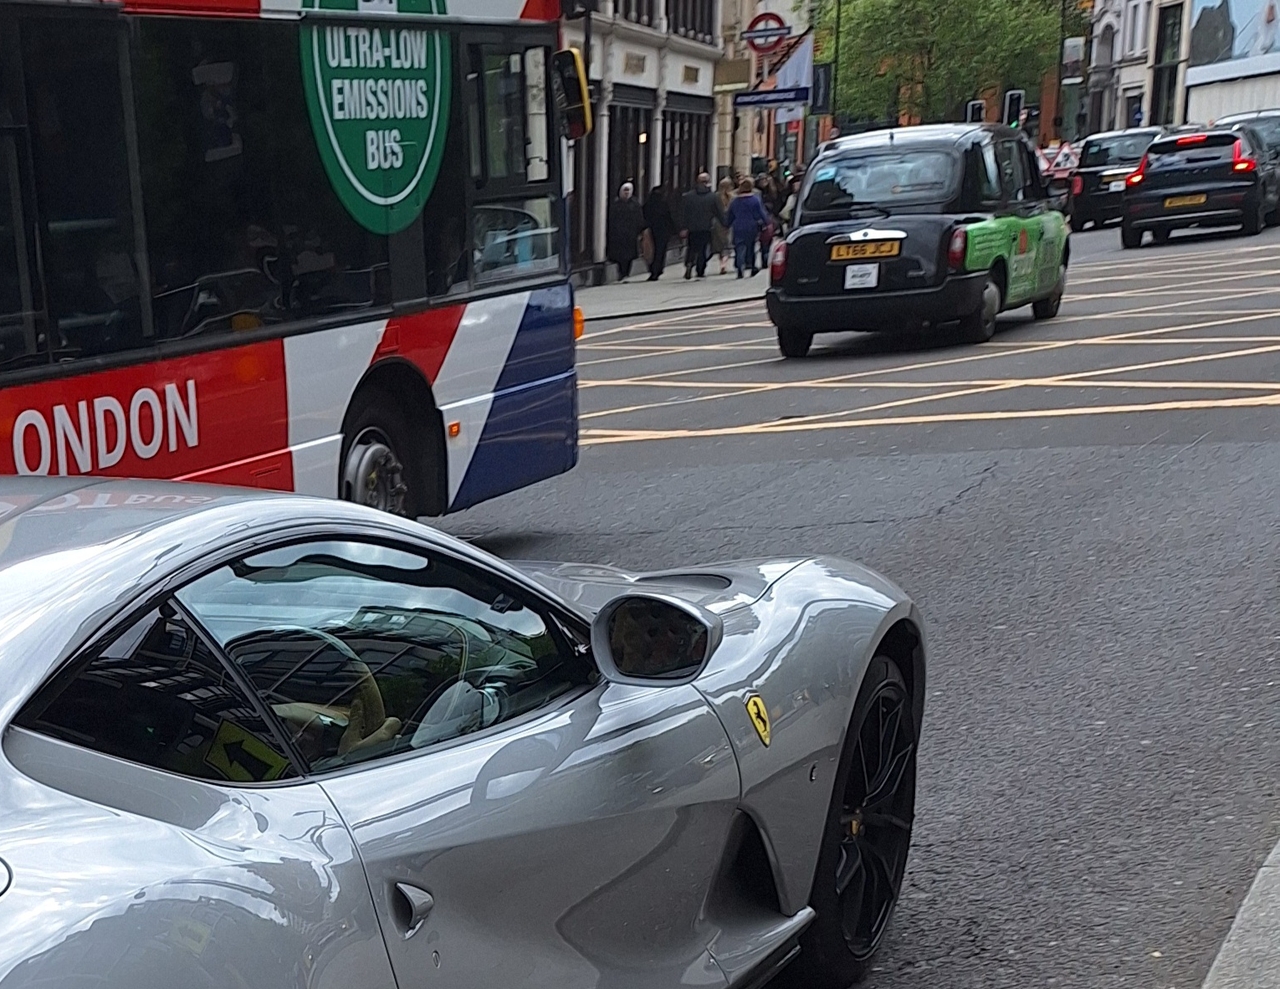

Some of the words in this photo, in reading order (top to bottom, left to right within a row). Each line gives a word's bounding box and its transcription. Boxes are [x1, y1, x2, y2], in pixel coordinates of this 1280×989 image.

[325, 26, 427, 69] ULTRA-LOW
[331, 79, 428, 120] EMISSIONS
[366, 128, 404, 170] BUS
[835, 244, 867, 258] LT66
